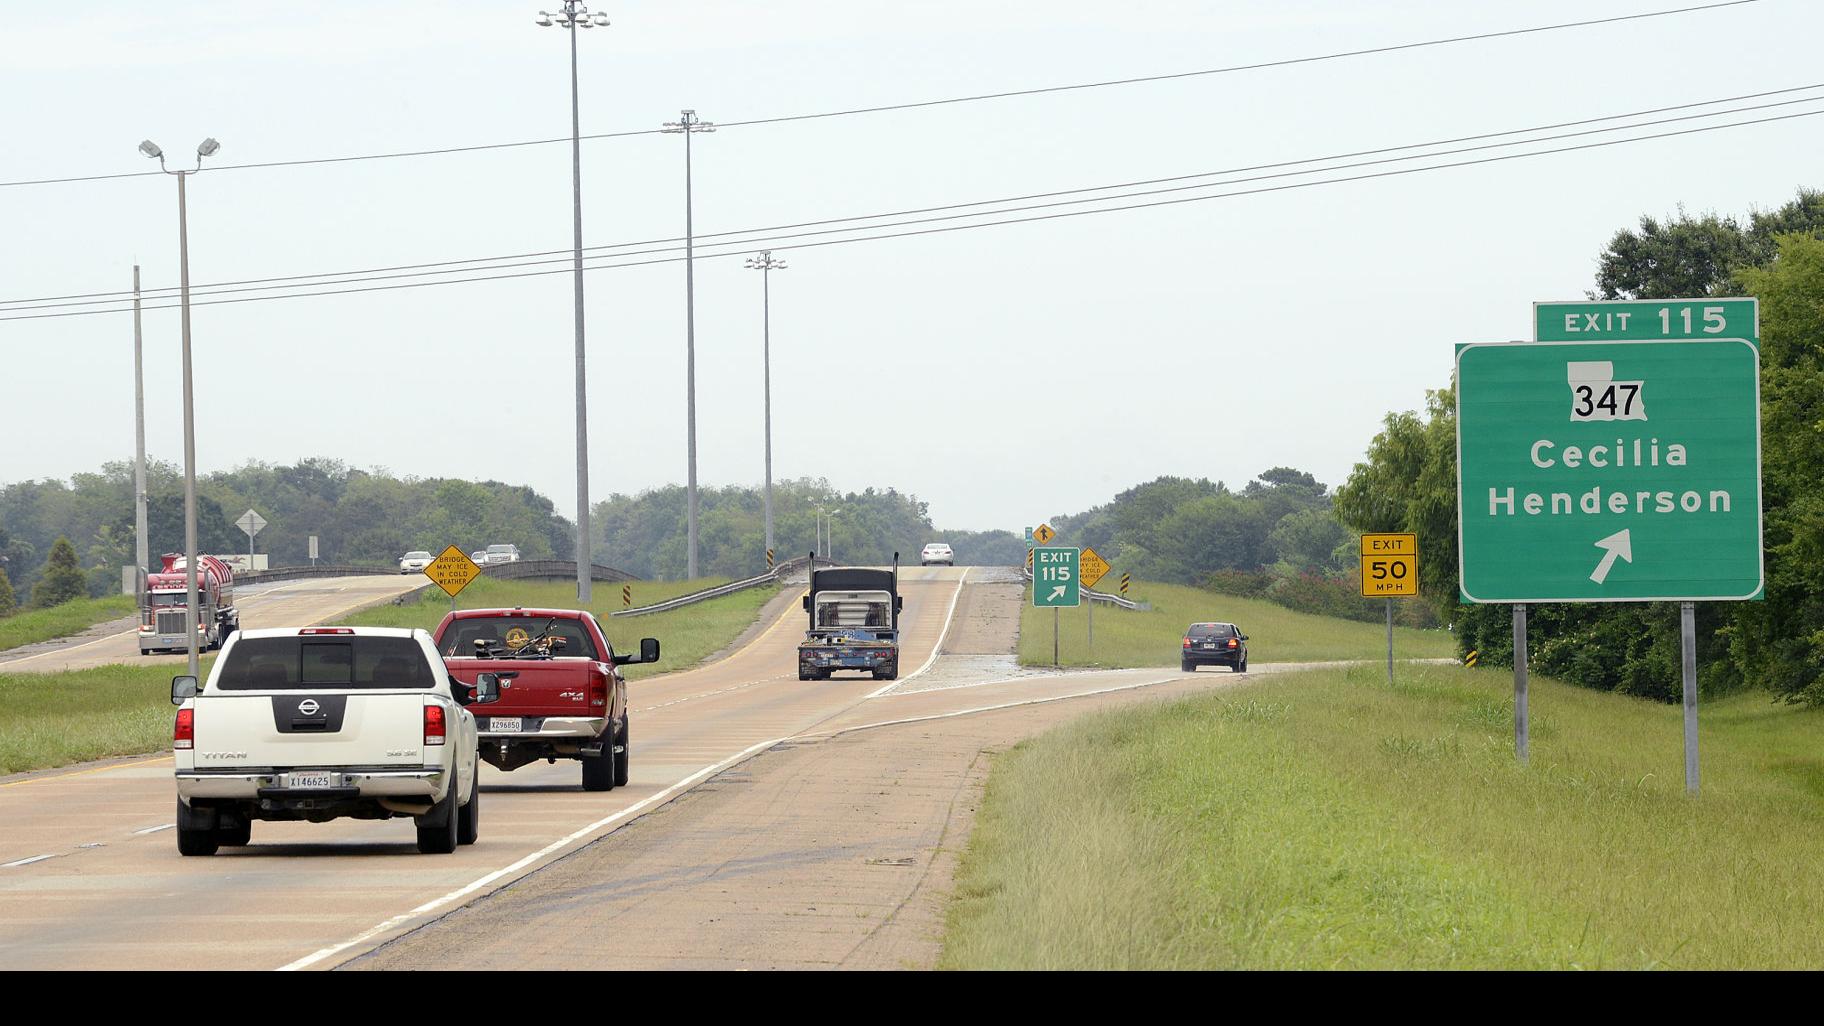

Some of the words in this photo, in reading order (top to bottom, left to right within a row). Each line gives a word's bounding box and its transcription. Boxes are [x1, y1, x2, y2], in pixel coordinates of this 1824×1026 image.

[1564, 312, 1631, 332] EXIT
[1658, 306, 1727, 334] 115
[1574, 384, 1639, 417] 347
[1530, 437, 1688, 469] Cecilia
[1488, 486, 1731, 516] Henderson
[1373, 540, 1403, 549] EXIT
[1040, 552, 1072, 562] EXIT
[1042, 566, 1071, 581] 115
[1372, 561, 1407, 580] 50
[1376, 583, 1403, 591] MPH
[291, 777, 329, 787] X146625
